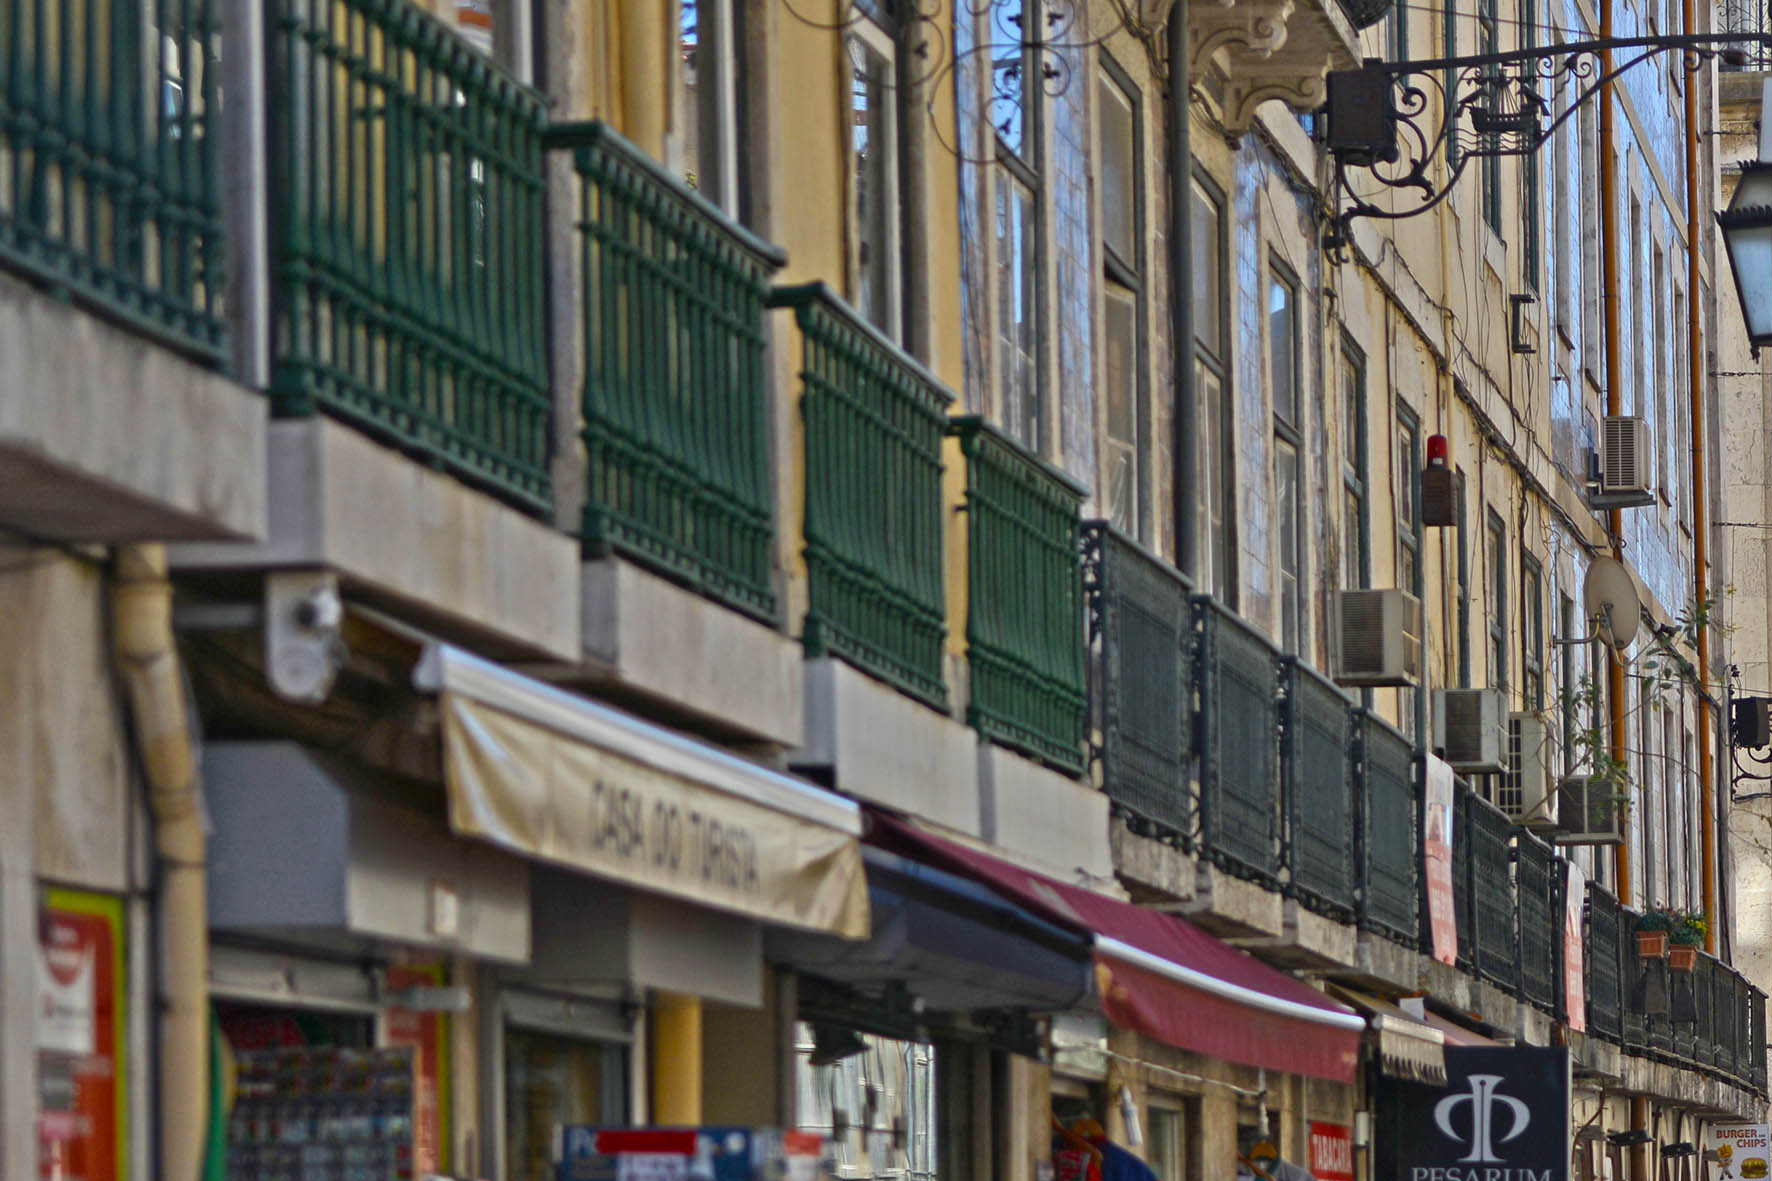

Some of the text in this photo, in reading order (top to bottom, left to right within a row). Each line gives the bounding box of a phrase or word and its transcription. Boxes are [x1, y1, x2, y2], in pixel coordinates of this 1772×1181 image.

[589, 777, 643, 858] CASA
[652, 797, 683, 870] DO
[1716, 1129, 1757, 1139] BURGER
[1736, 1138, 1767, 1148] CHIPS
